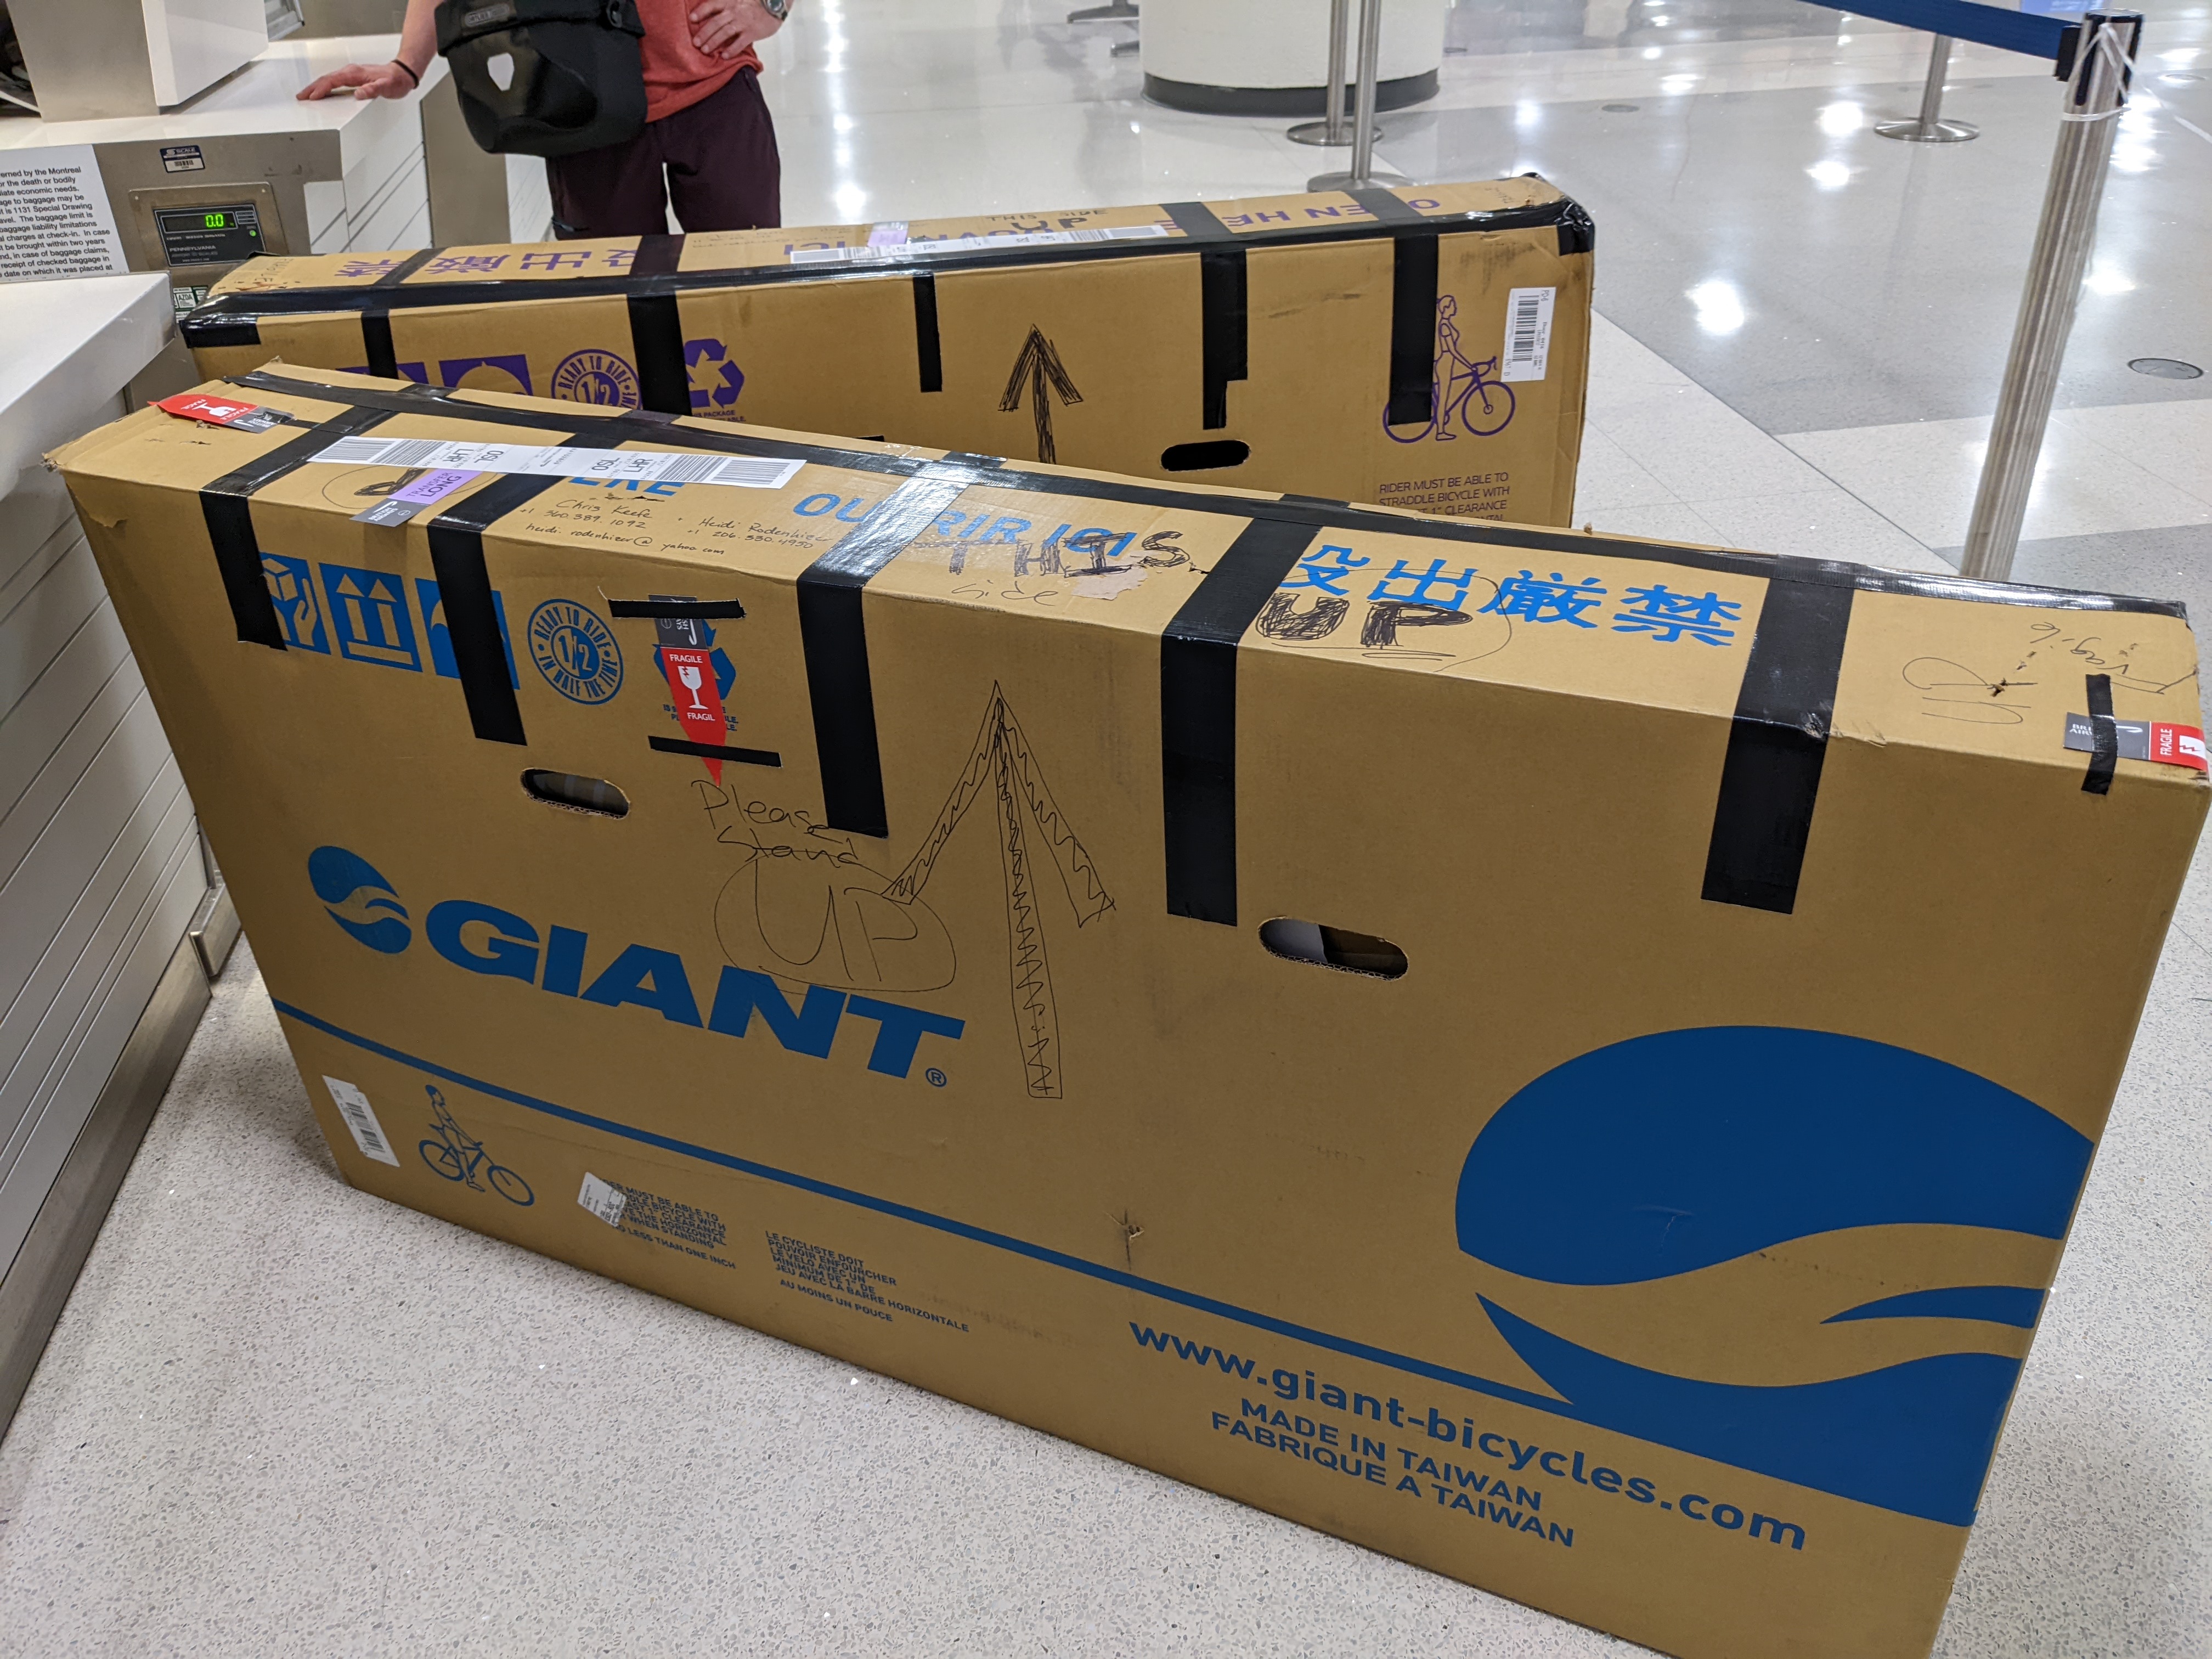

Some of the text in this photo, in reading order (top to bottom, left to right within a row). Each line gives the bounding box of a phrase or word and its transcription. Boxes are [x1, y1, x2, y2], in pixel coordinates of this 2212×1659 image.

[206, 214, 224, 227] 0.0
[1011, 217, 1088, 230] UP
[558, 356, 631, 390] READY TO RIDE
[180, 399, 206, 410] FRAGIL
[221, 407, 249, 420] FRAGILE
[443, 448, 474, 462] LHR
[475, 450, 504, 464] OSL
[591, 457, 620, 471] OSL
[623, 458, 653, 472] LHR
[405, 472, 453, 497] TRANSFER
[420, 476, 462, 497] LONG
[1379, 486, 1510, 506] STRADDLE BICYCLE WITH
[1380, 472, 1509, 493] RIDER MUST BE ABLE TO
[368, 507, 392, 521] BRITISH
[374, 507, 398, 522] AIRWAYS
[556, 499, 653, 518] Chris Keefe
[1444, 500, 1506, 515] CLEARANCE
[698, 516, 741, 529] Heidi
[663, 543, 696, 551] yahoo
[914, 531, 1189, 578] THIS
[534, 606, 611, 648] READY TO RIDE
[1256, 592, 1472, 649] UP
[558, 635, 592, 672] 1/2
[669, 654, 703, 663] FRAGILE
[538, 656, 618, 698] IN HALF THE TIME
[687, 712, 715, 721] FRAGIL
[2160, 729, 2172, 756] FRAGILE
[755, 859, 918, 982] UP
[426, 900, 965, 1079] GIANT
[626, 1187, 719, 1222] MUST BE ABLE TO
[651, 1201, 726, 1232] BICYCLE WITH
[629, 1216, 714, 1249] WHEN STANDING
[660, 1218, 726, 1246] HORIZONTAL
[661, 1212, 726, 1239] CLEARANCE
[629, 1227, 736, 1269] LESS THAN ONE INCH
[765, 1231, 864, 1268] LE CYCLISTE DOIT
[768, 1239, 897, 1286] POUVOIR ENFOURCHER
[770, 1246, 866, 1284] LE VELO AVEC UN
[772, 1255, 876, 1295] MINIMUM DE DE
[776, 1263, 970, 1333] JEU AVEC LA BARRE HORIZONTALE
[780, 1279, 893, 1322] AU MOINS UN POUCE
[1128, 1321, 1807, 1550] www.giant-bicycles.com
[1240, 1398, 1543, 1512] MADE IN TAIWAN
[1211, 1411, 1574, 1548] FABRIQUE A TAIWAN
